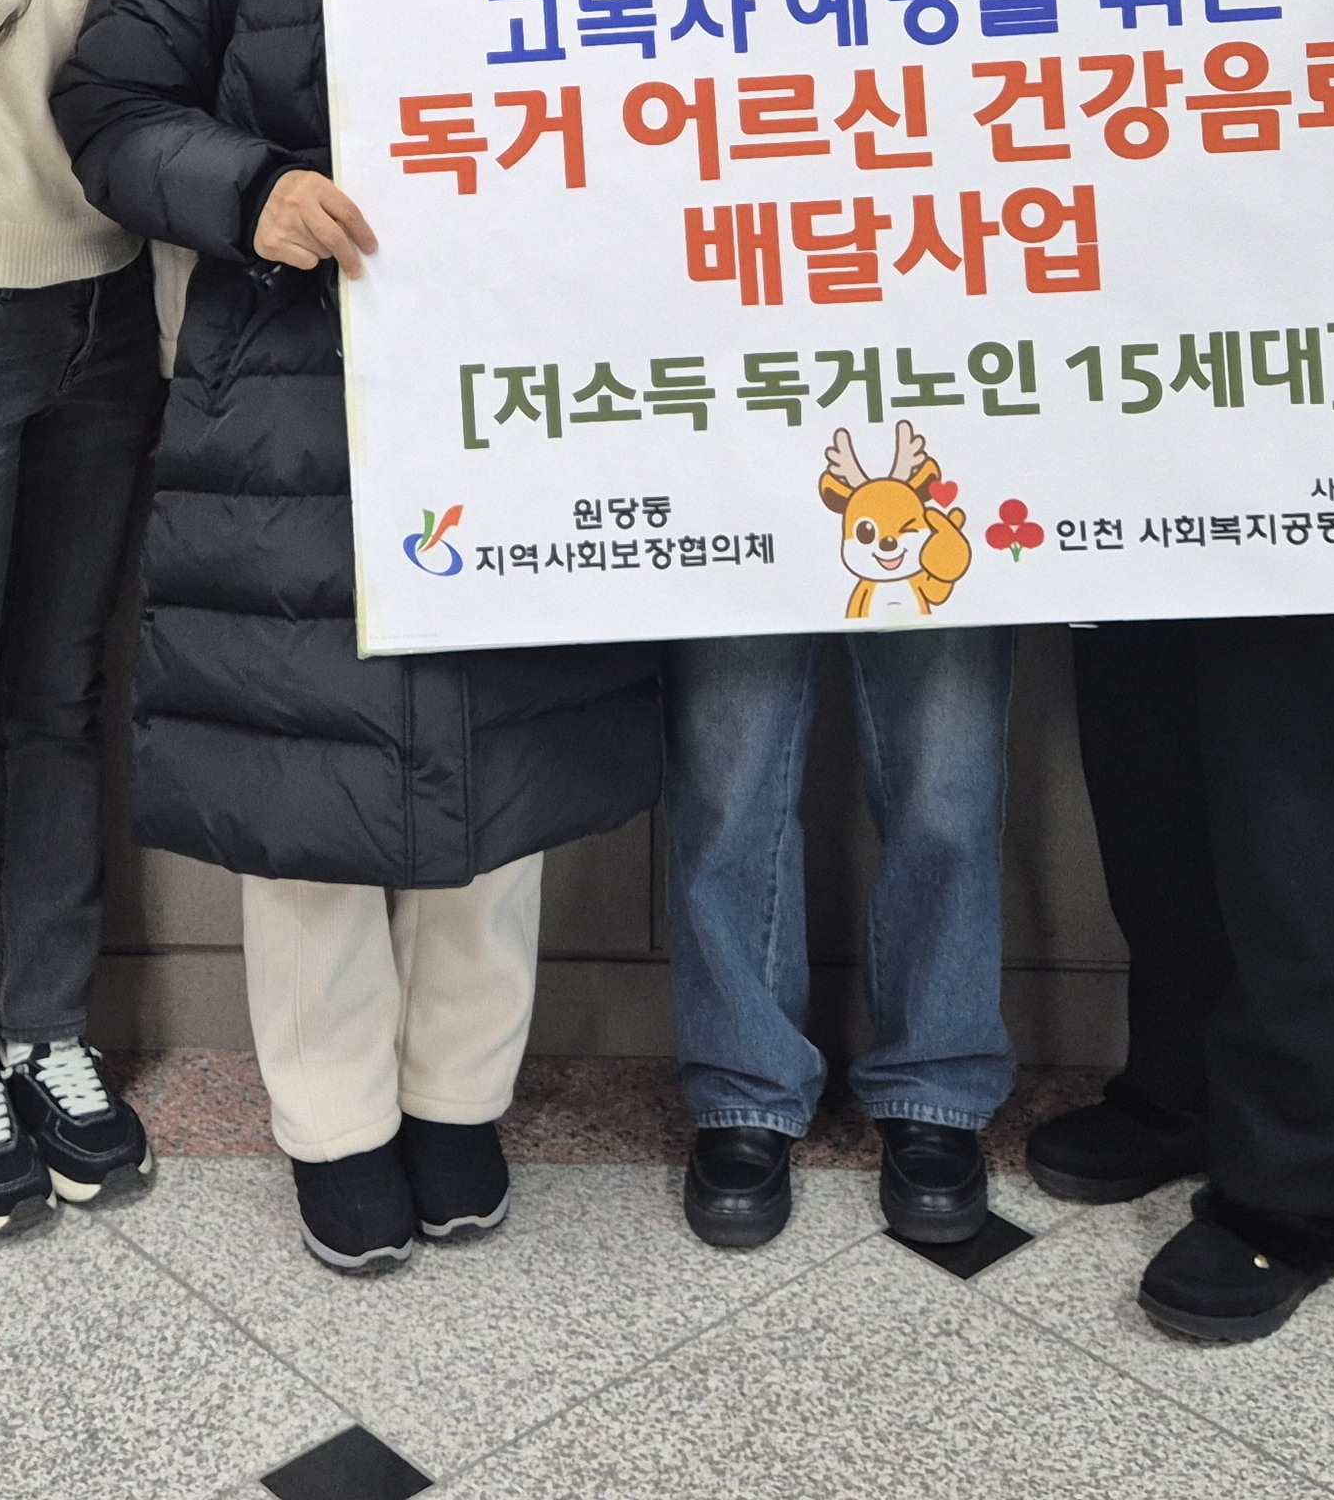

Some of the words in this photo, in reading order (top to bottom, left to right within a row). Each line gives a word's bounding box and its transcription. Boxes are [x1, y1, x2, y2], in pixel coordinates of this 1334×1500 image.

[389, 85, 588, 195] 독거
[623, 63, 932, 183] 어르신
[684, 183, 1102, 308] 배달사업
[459, 352, 717, 450] [저소득
[735, 340, 1038, 430] 독거노인
[572, 495, 672, 530] 원당동
[1055, 516, 1124, 552] 인천
[475, 531, 775, 576] 지역사회보장협의체
